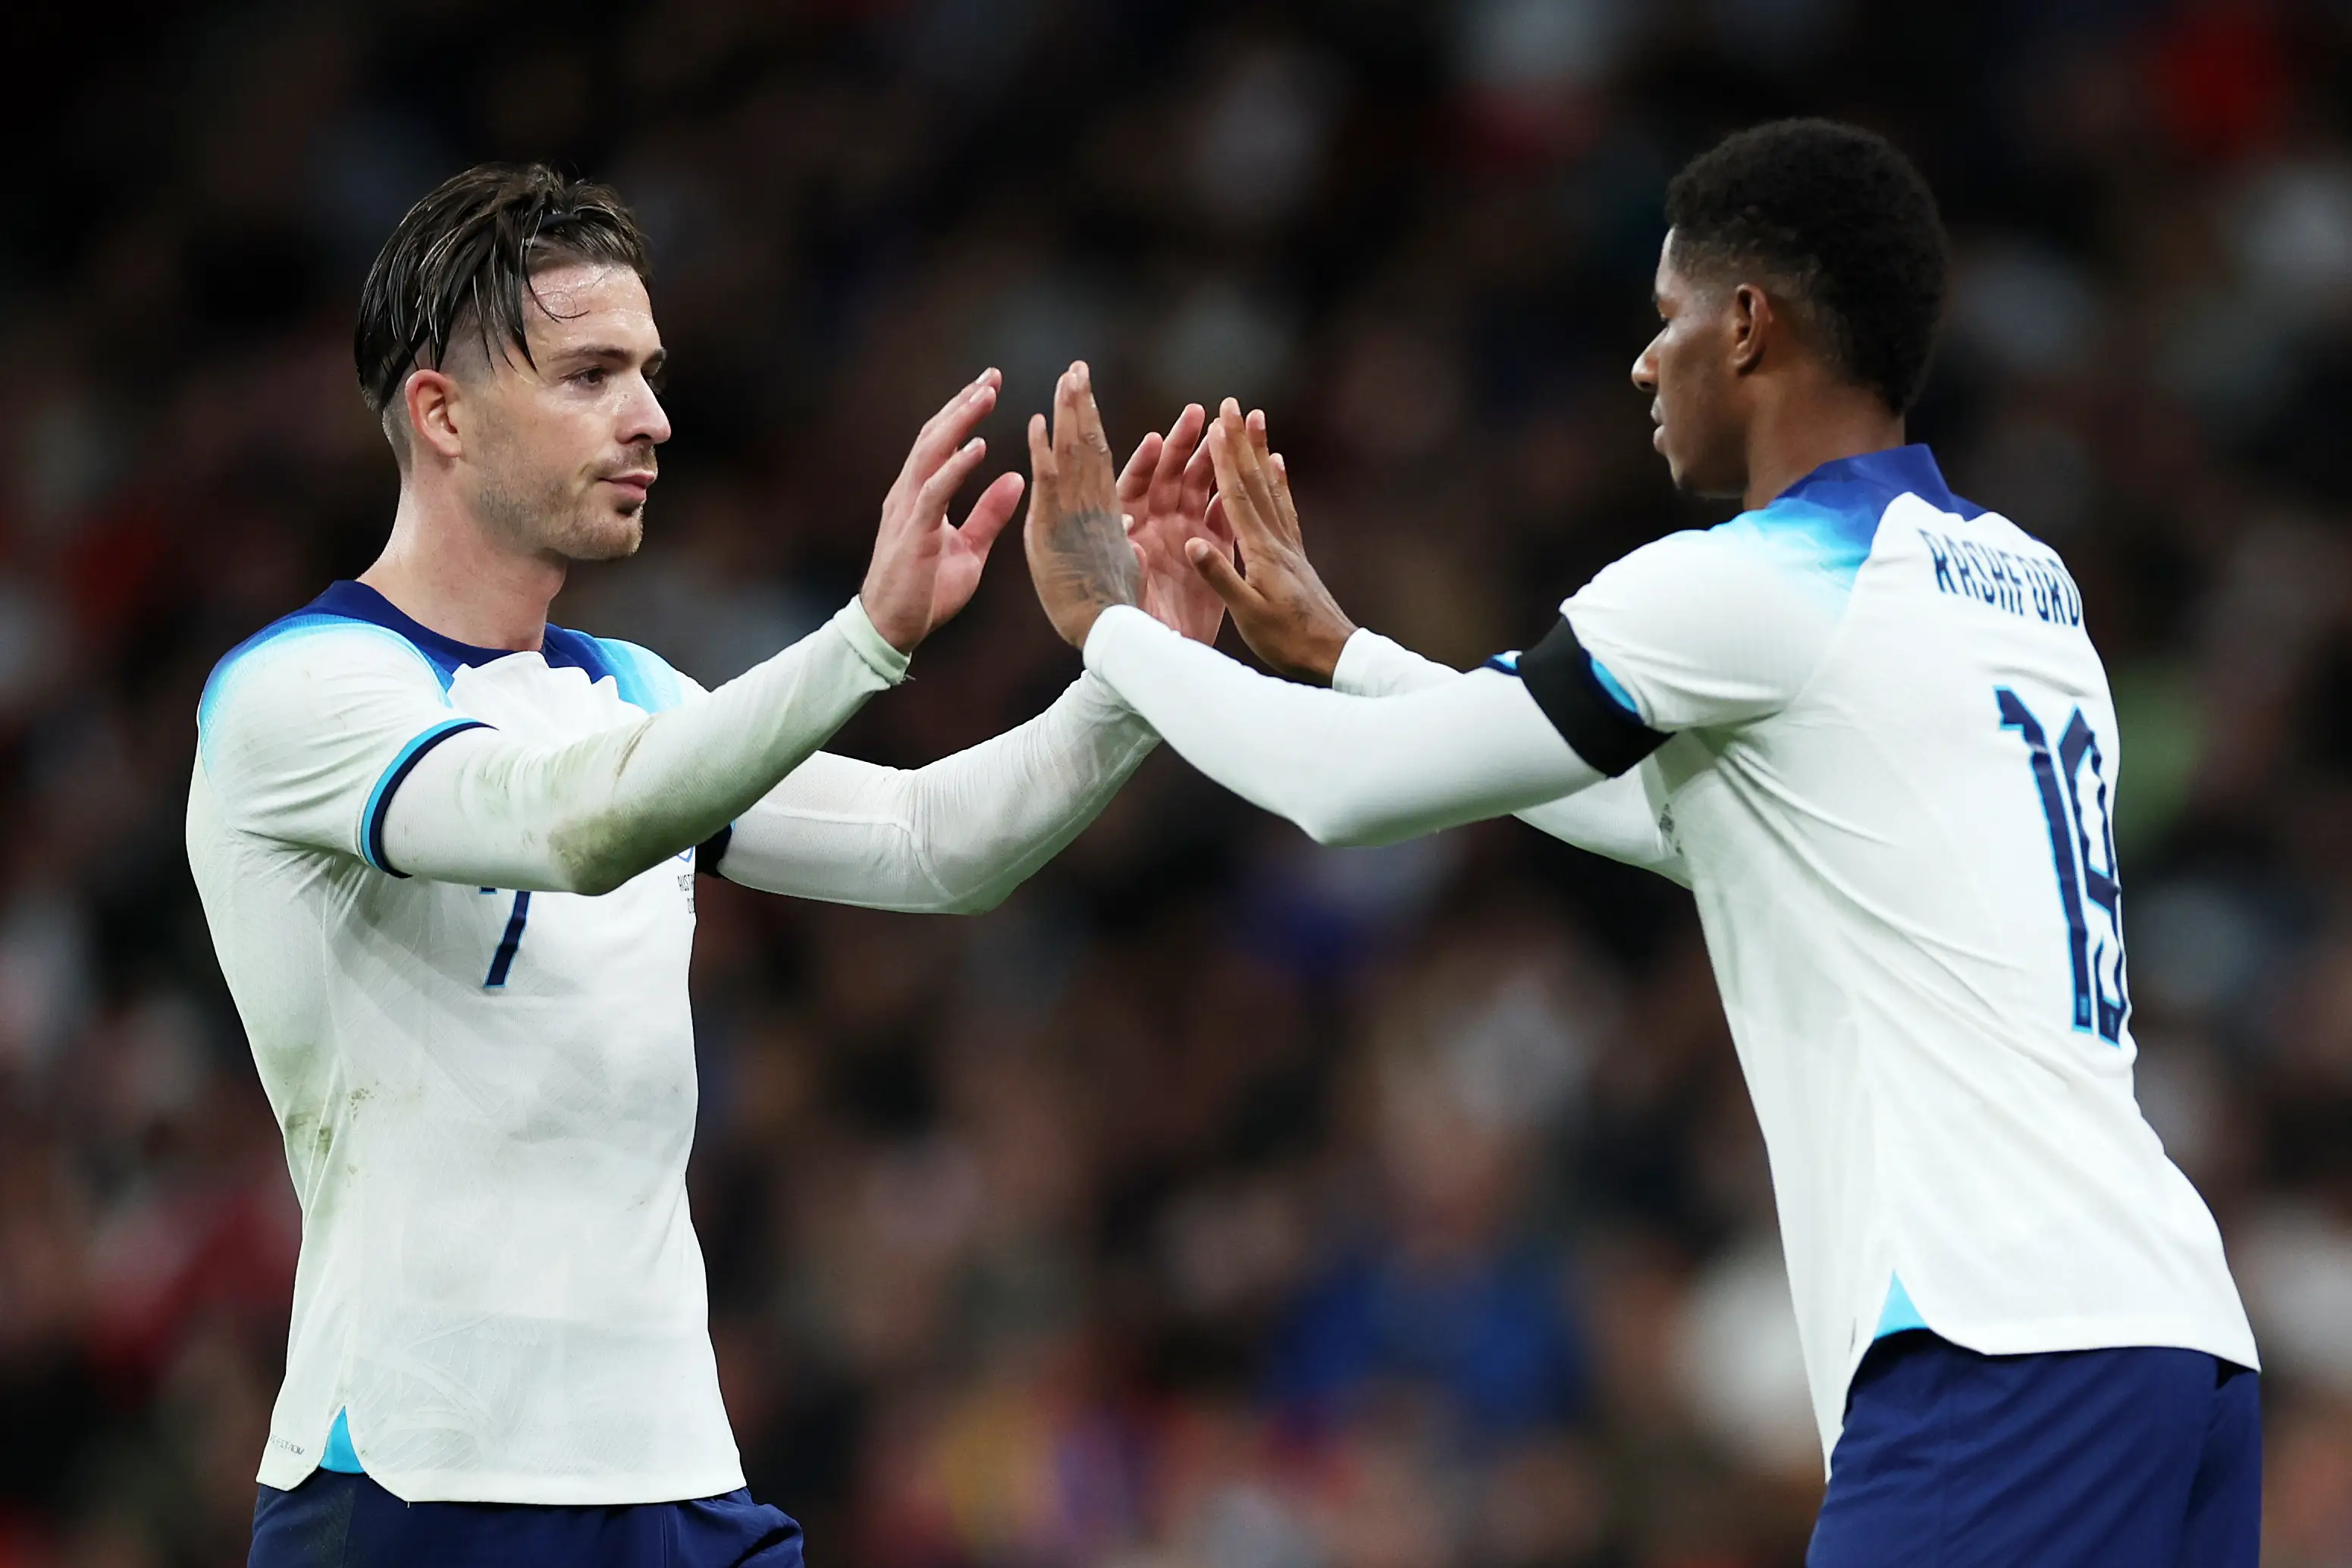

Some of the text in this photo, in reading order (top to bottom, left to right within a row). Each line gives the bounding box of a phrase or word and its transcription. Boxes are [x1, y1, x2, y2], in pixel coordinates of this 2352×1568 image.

[1917, 528, 2080, 627] RASHFORD
[1993, 685, 2127, 1049] 19
[478, 886, 532, 989] 7
